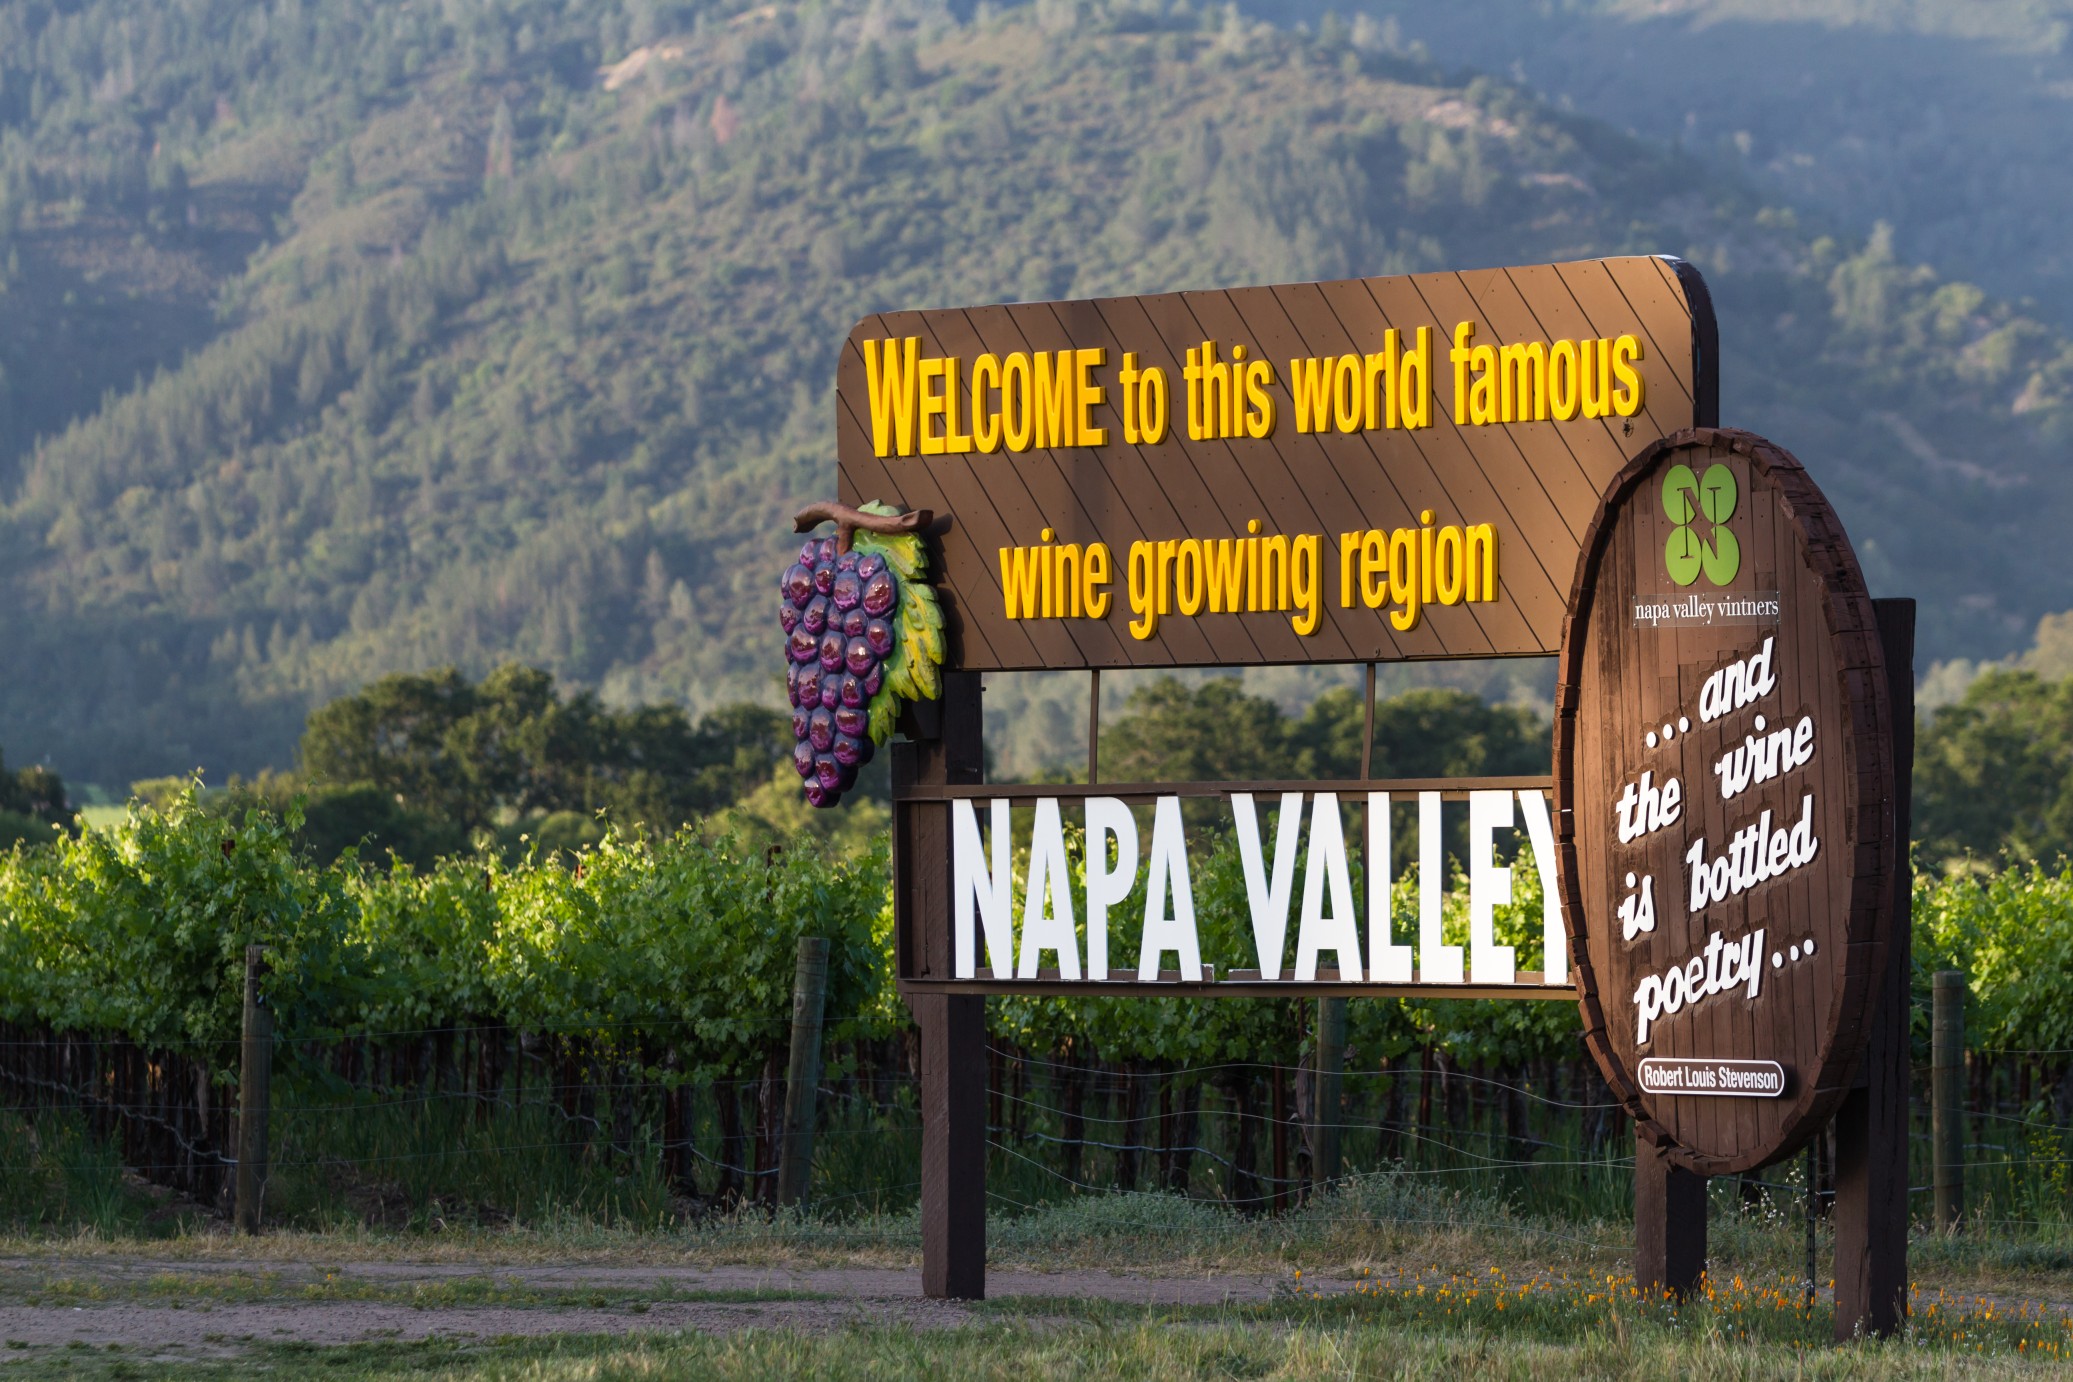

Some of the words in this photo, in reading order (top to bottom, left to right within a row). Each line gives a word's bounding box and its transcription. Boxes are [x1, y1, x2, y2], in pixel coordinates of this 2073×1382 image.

[864, 336, 1108, 457] WELCOME
[1120, 352, 1169, 445] to
[1184, 340, 1276, 441] this
[1291, 326, 1433, 434] world
[1450, 321, 1645, 426] famous
[999, 528, 1112, 620] wine
[1129, 519, 1322, 640] growing
[1341, 509, 1499, 631] region
[1635, 603, 1670, 626] napa
[1673, 595, 1715, 624] valley
[1717, 595, 1779, 617] vintners
[1616, 770, 1681, 844] the
[1715, 715, 1813, 799] wine
[953, 797, 1202, 981] NAPA
[1617, 872, 1656, 941] is
[1686, 794, 1817, 913] bottled
[1633, 928, 1815, 1045] poetry...
[1644, 1065, 1683, 1087] Robert
[1685, 1066, 1716, 1088] Louis
[1719, 1066, 1778, 1090] Stevenson
